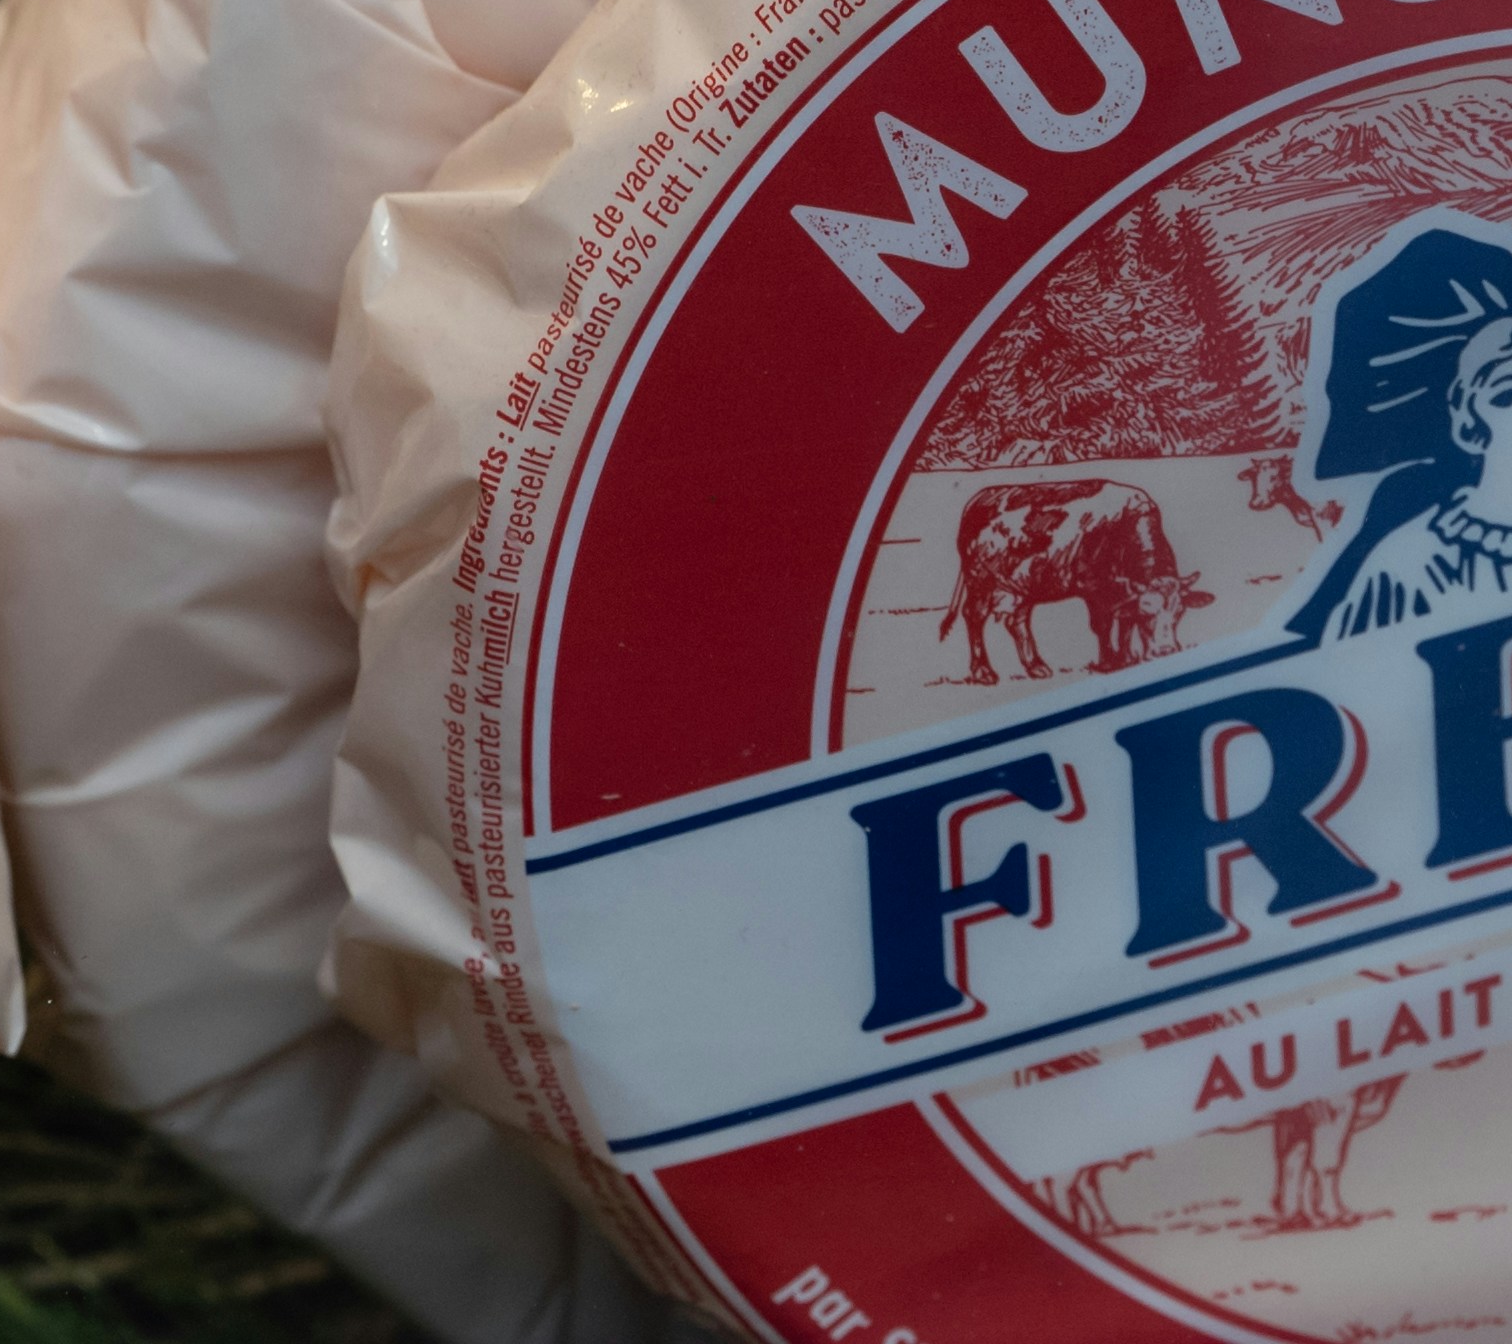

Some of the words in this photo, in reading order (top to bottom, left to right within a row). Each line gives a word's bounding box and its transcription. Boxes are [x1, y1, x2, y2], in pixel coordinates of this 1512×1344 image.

[666, 41, 749, 133] (Origine
[718, 35, 811, 129] Zutaten
[614, 131, 674, 204] vache
[692, 127, 732, 156] Tr.
[592, 204, 624, 239] de
[642, 173, 694, 229] Fett
[605, 226, 657, 290] 45%
[527, 235, 603, 375] pasteurisé
[496, 371, 538, 430] Lait
[532, 291, 622, 437] Mindestens
[489, 443, 555, 583] hergestellt.
[450, 603, 474, 679] vache.
[474, 586, 516, 710] Kuhmilch
[444, 682, 467, 715] de
[442, 718, 474, 854] pasteurisé
[474, 714, 514, 898] pasteurisierter
[491, 909, 516, 954] aus
[1193, 1033, 1301, 1115] AU
[1334, 976, 1503, 1071] LAIT
[771, 1265, 872, 1341] par
